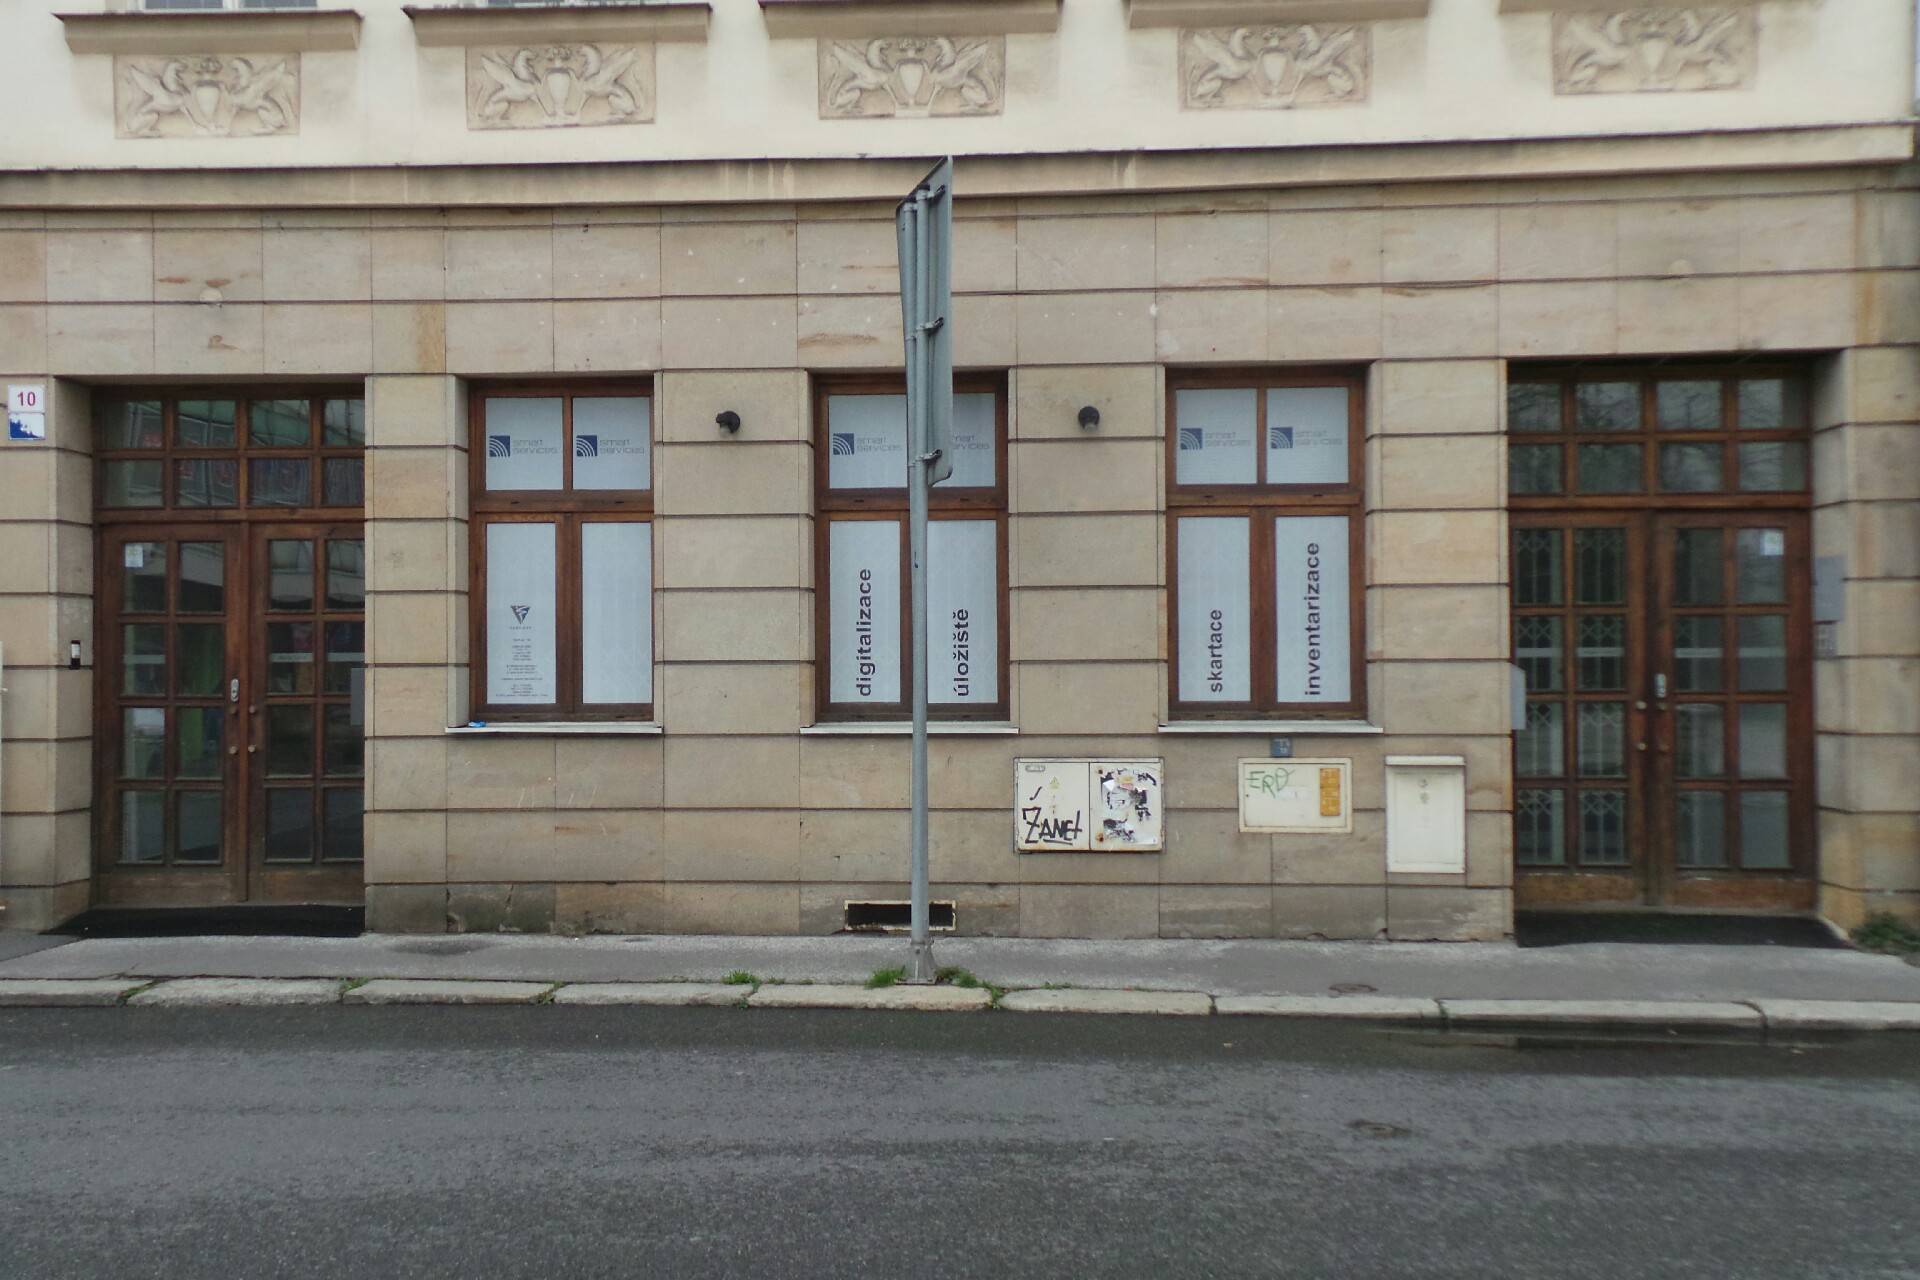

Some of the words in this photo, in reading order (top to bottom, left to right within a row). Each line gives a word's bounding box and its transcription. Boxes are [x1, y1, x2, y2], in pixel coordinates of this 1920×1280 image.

[17, 391, 36, 407] 10
[513, 446, 557, 454] services
[600, 446, 645, 454] services
[952, 442, 990, 450] ervices
[856, 568, 876, 697] digitalizace
[1304, 542, 1321, 696] inventarizace
[952, 608, 969, 697] úložiště
[1207, 609, 1223, 693] skartace
